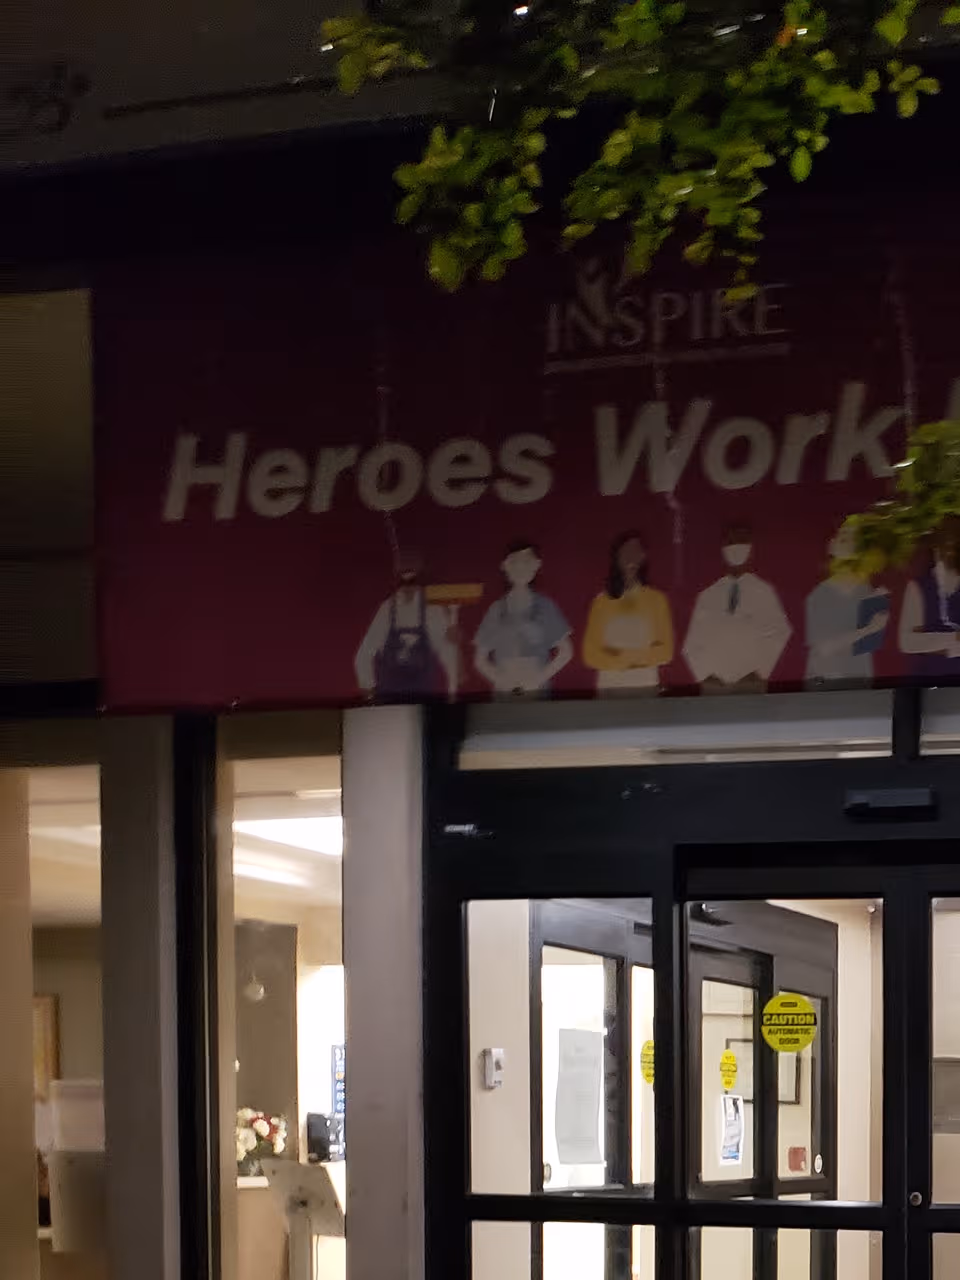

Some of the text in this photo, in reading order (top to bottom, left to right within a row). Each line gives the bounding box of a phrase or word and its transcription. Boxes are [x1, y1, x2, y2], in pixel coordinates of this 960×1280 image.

[545, 282, 791, 353] INSPIRE
[161, 430, 555, 522] Heroes
[593, 379, 903, 496] Work
[763, 1014, 815, 1025] CAUTION
